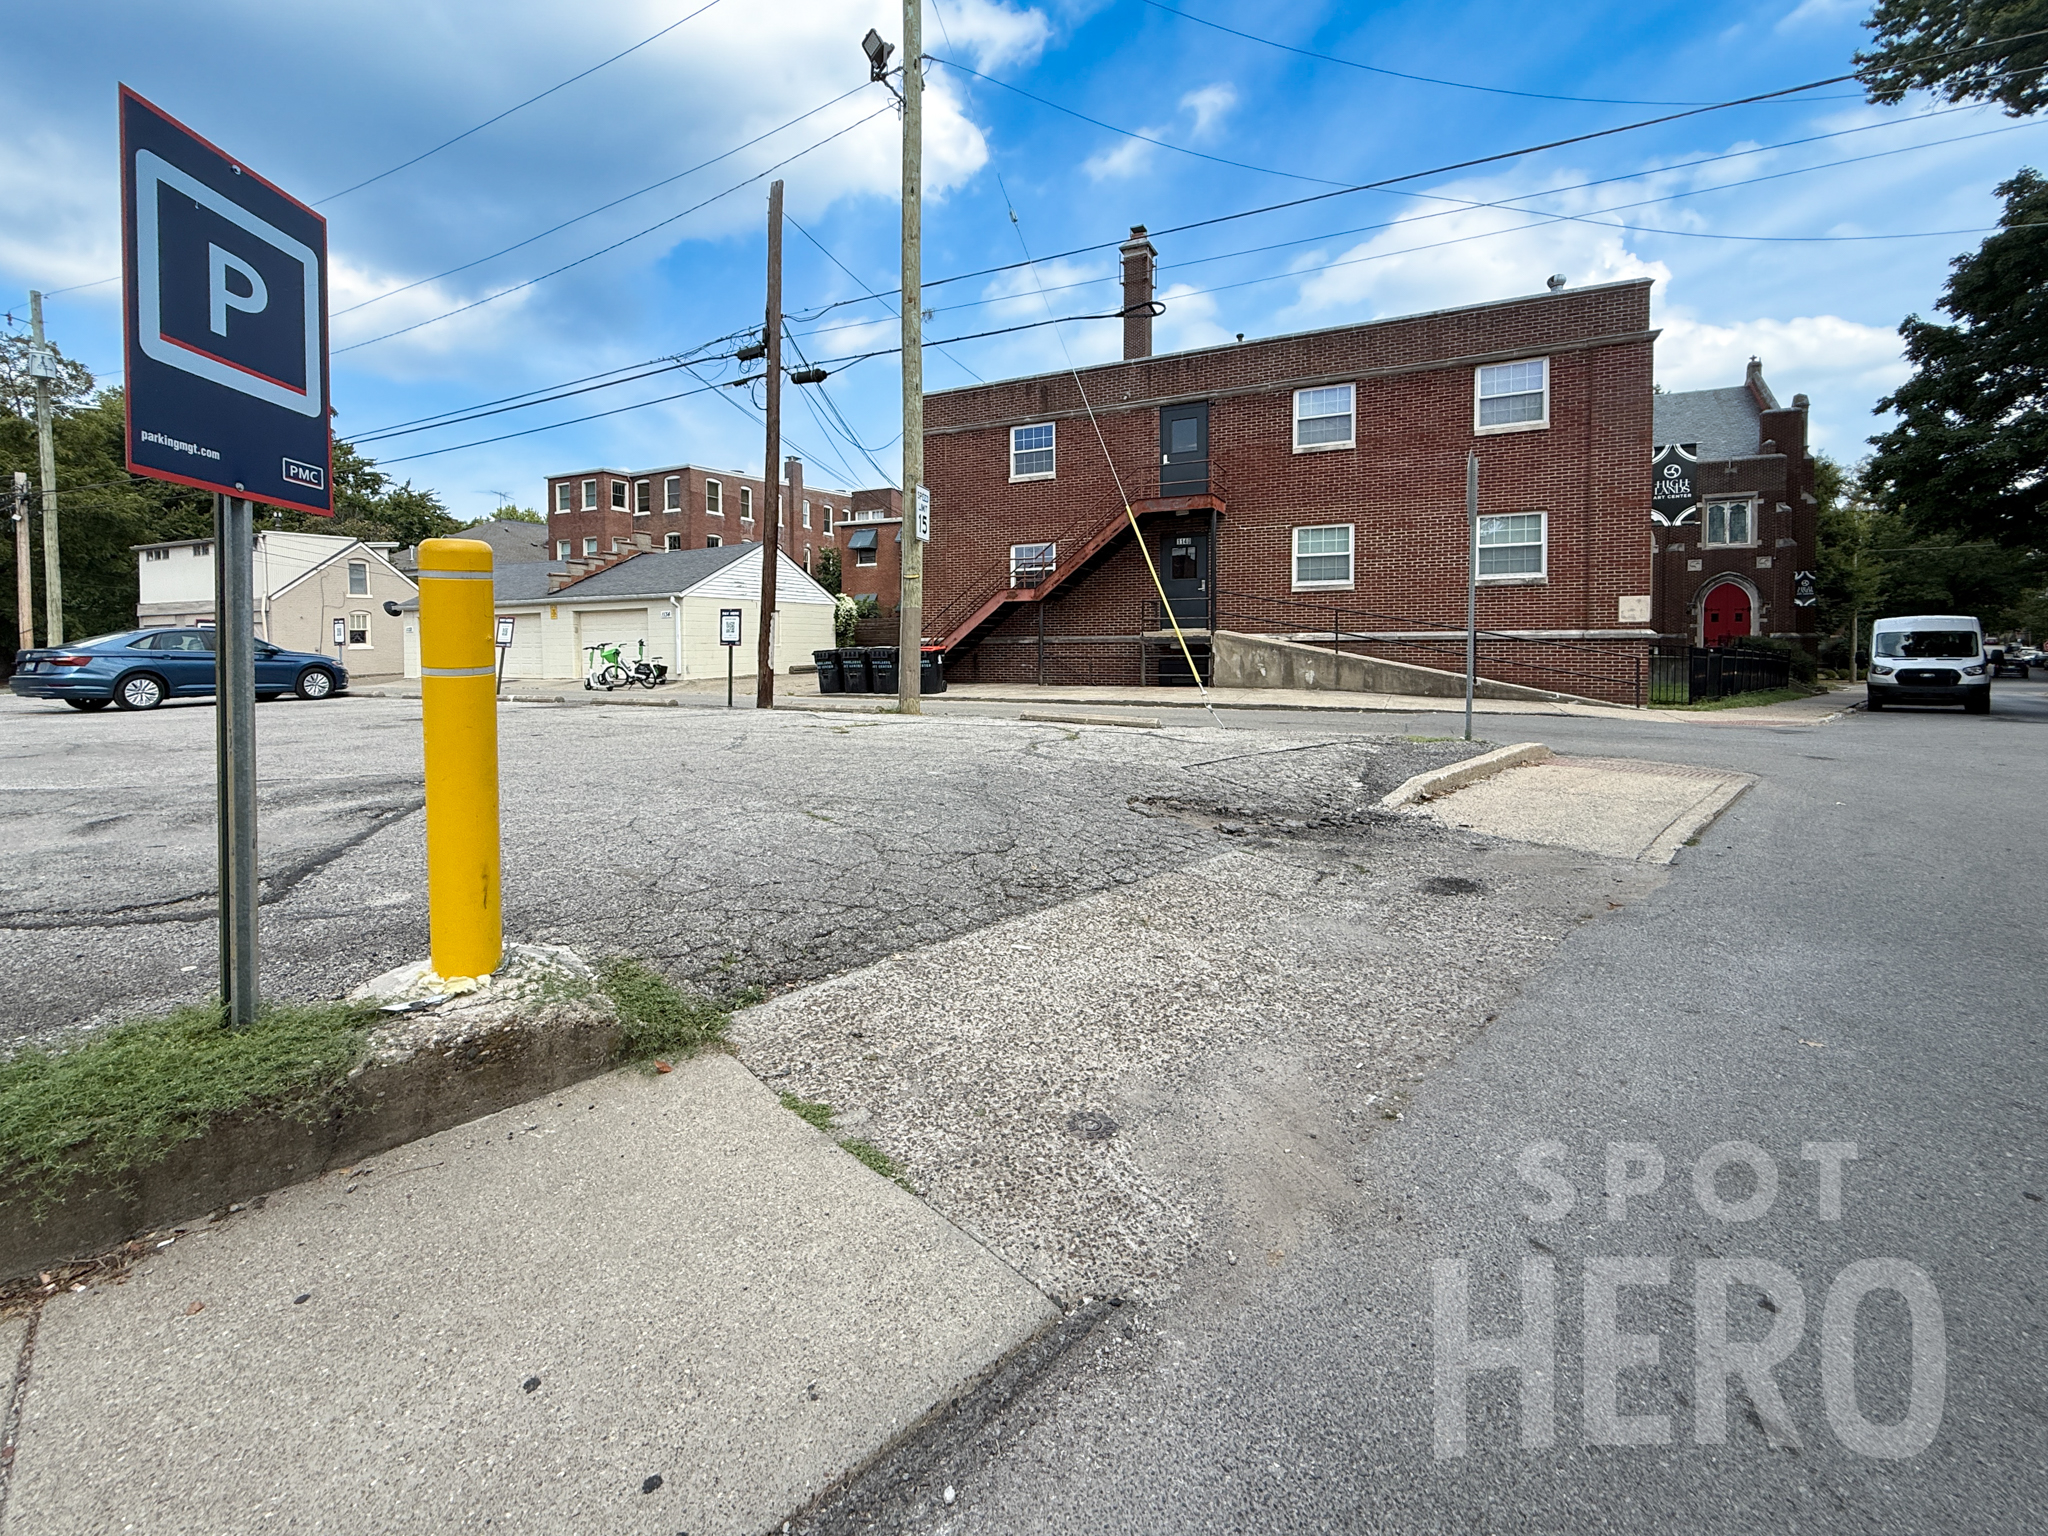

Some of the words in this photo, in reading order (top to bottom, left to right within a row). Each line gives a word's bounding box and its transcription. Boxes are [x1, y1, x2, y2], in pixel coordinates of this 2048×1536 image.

[208, 241, 269, 338] P
[140, 430, 221, 460] parkingmgt.com
[289, 464, 319, 484] PMC
[918, 514, 928, 535] 15
